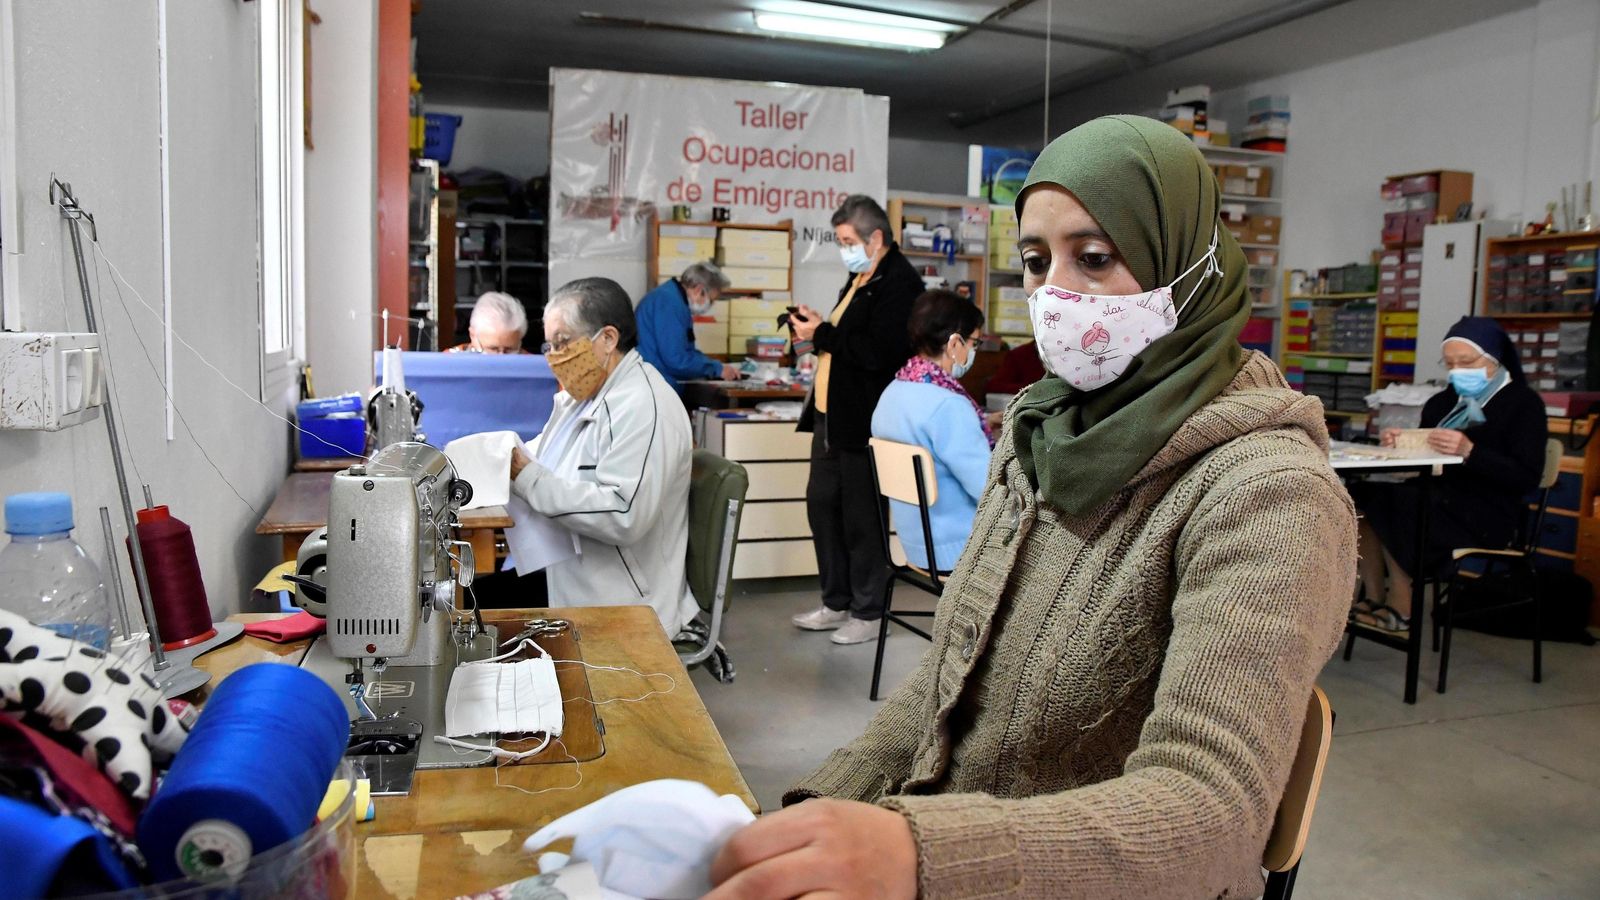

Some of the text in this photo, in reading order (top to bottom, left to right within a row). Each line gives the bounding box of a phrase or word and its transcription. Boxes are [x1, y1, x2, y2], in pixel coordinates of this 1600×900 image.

[735, 100, 809, 130] Taller
[683, 136, 855, 173] Ocupacional
[667, 176, 849, 214] de Emigrante
[1103, 302, 1126, 317] star
